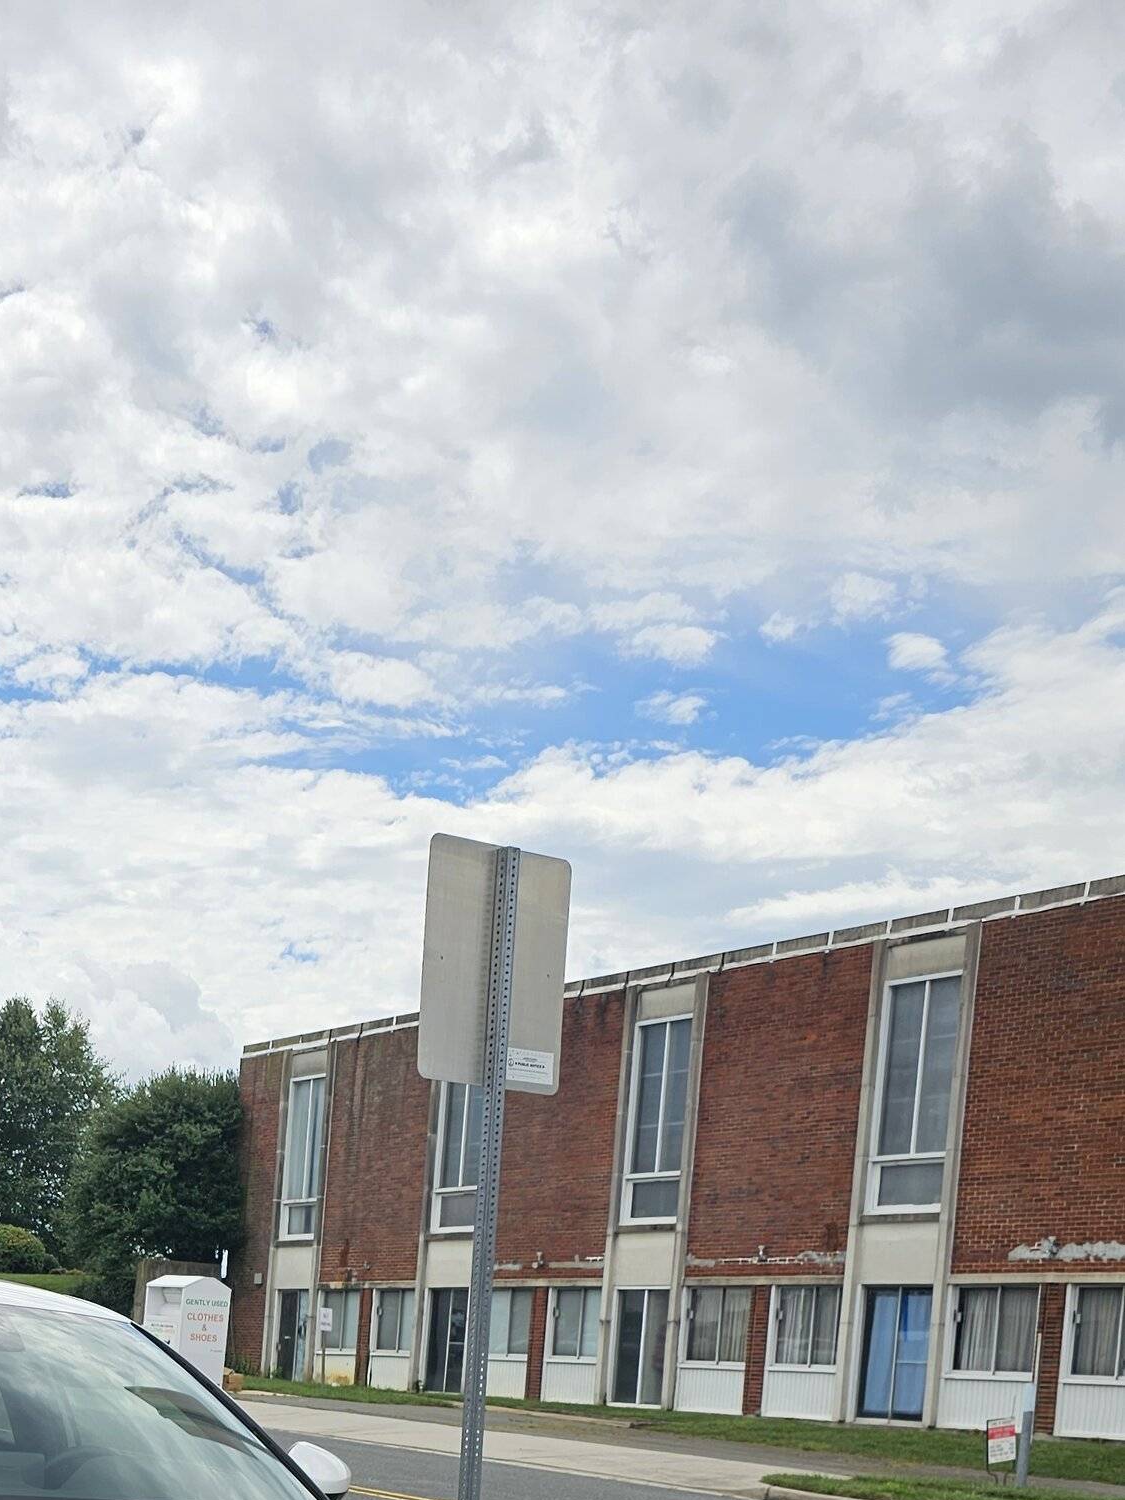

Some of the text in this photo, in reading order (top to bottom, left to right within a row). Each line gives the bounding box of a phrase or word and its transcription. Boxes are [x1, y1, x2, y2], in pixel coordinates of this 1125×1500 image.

[185, 1298, 229, 1308] GENTLY USED
[186, 1312, 224, 1323] CLOTHES
[201, 1324, 207, 1332] &
[190, 1333, 218, 1343] SHOES
